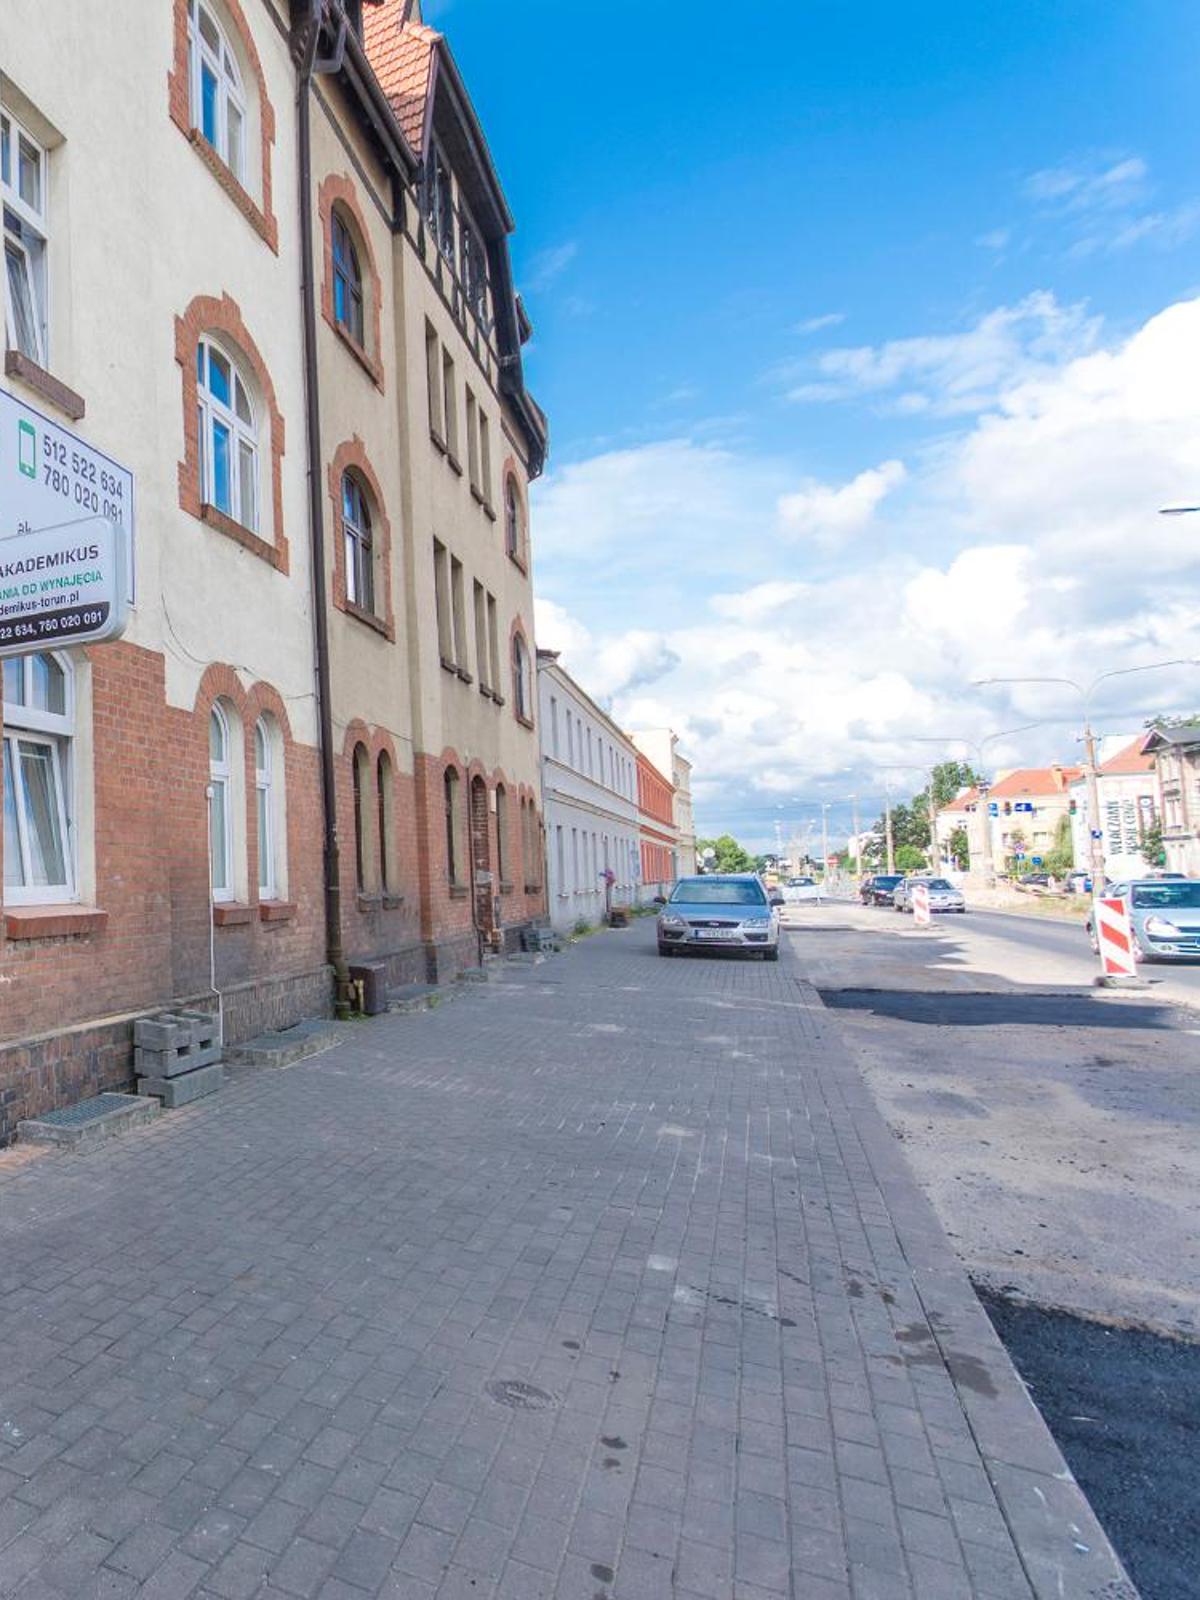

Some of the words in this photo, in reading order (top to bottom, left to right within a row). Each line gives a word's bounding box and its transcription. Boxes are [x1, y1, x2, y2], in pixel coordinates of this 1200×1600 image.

[43, 433, 67, 467] 512
[71, 451, 97, 485] 522
[100, 471, 123, 500] 634
[43, 463, 70, 497] 780
[74, 482, 99, 513] 020
[103, 499, 123, 526] 091
[40, 570, 104, 593] WYNAJĘCIA
[39, 618, 59, 633] 780
[60, 613, 81, 629] 020
